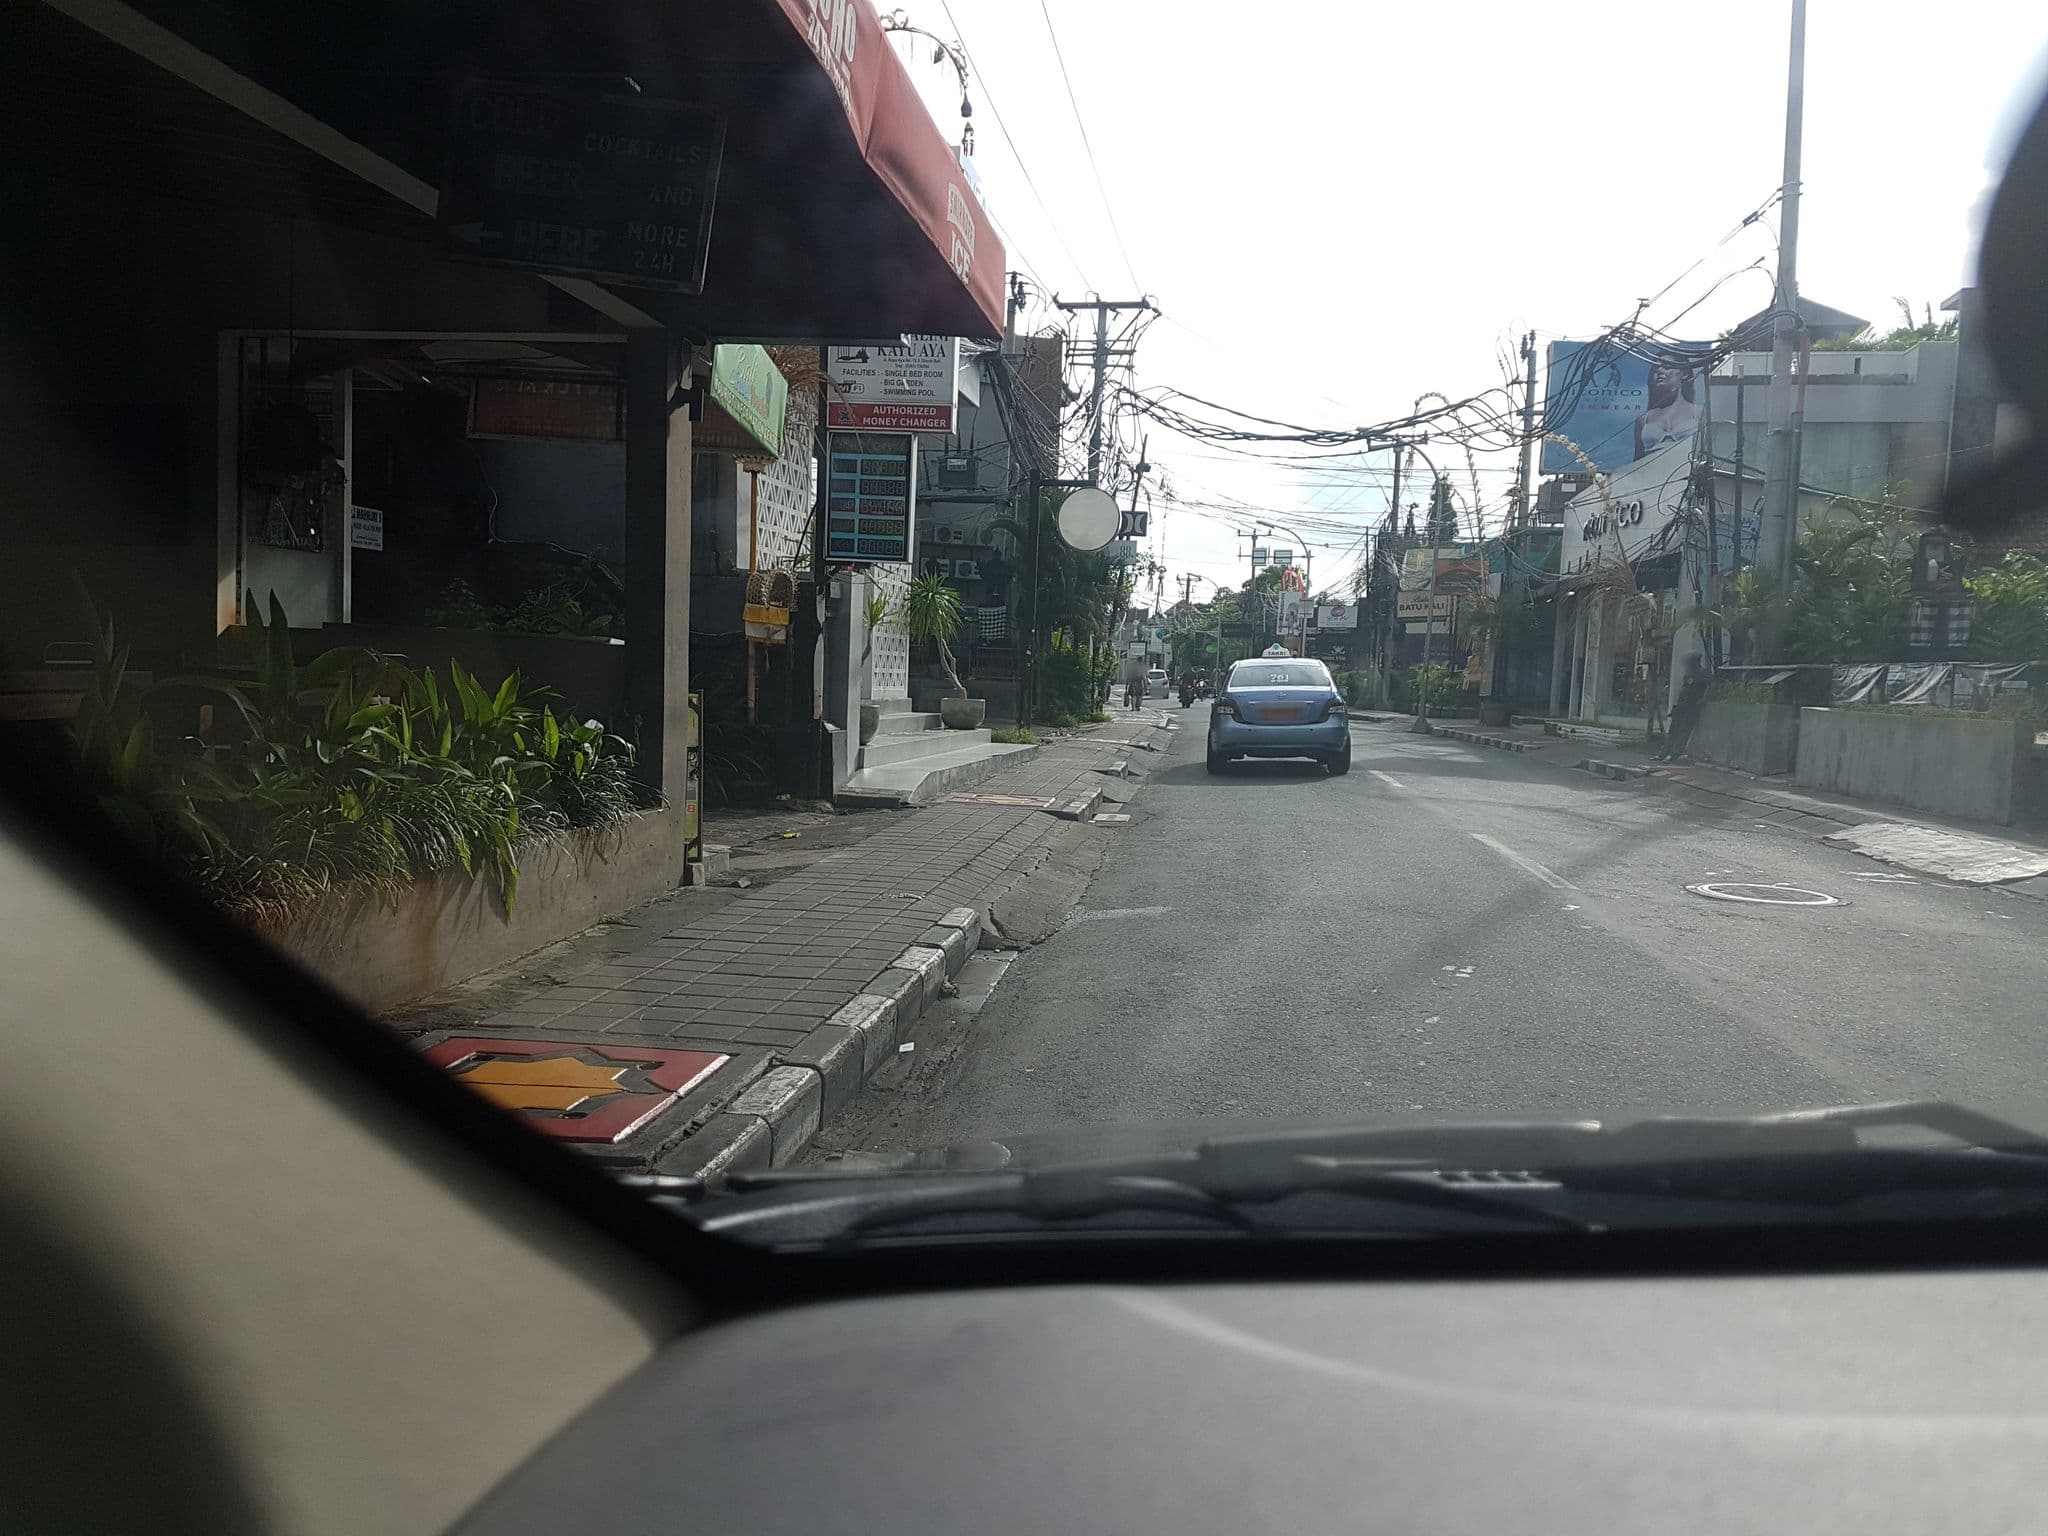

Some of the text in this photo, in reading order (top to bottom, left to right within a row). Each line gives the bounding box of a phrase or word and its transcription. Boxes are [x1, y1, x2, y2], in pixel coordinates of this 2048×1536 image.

[809, 0, 857, 62] HO
[583, 132, 701, 165] COCKTAILS
[648, 184, 694, 206] AND
[513, 218, 608, 266] HERE
[626, 221, 690, 248] MORE
[950, 226, 971, 286] ICE
[842, 368, 944, 378] FACILITIES SINGLE BED ROOM
[884, 388, 937, 397] SWIMMING POOL
[873, 405, 937, 416] AUTHORIZED
[863, 417, 947, 428] MONEY CHANGER
[1399, 603, 1423, 611] BATU
